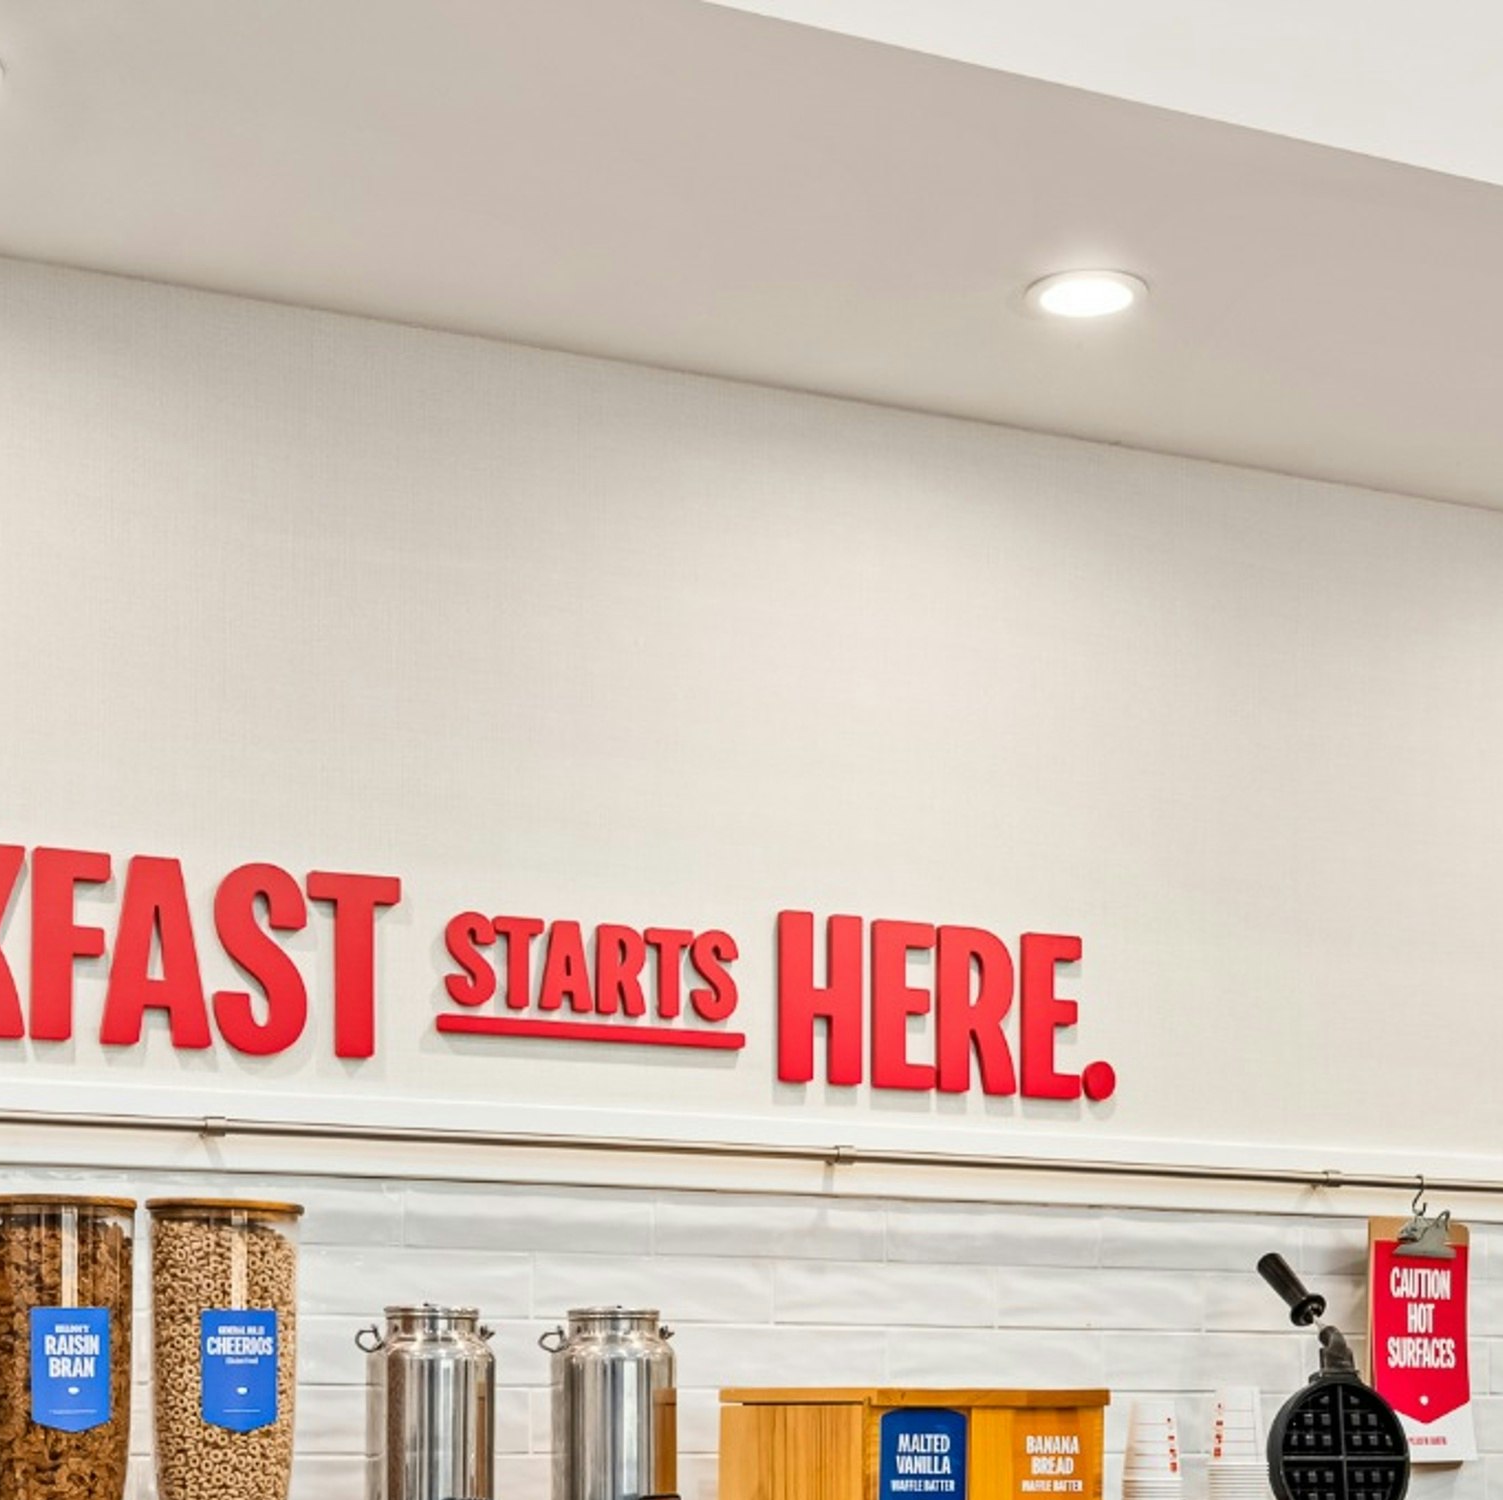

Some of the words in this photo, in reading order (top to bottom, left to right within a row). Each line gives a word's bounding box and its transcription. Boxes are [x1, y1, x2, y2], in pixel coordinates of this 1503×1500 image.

[444, 911, 739, 1023] STARTS
[777, 910, 1116, 1102] HERE.
[1389, 1266, 1451, 1300] CAUTION
[1407, 1302, 1435, 1334] HOT
[44, 1334, 100, 1355] RAISIN
[206, 1336, 274, 1355] CHEERIOS
[1387, 1336, 1456, 1369] SURFACES
[48, 1356, 96, 1378] BRAN
[898, 1433, 951, 1453] MALTED
[1026, 1435, 1080, 1454] BANANA
[896, 1455, 952, 1474] VANILLA
[1031, 1456, 1074, 1475] BREAD
[890, 1480, 922, 1492] WAFFLE
[923, 1480, 955, 1492] BATTER
